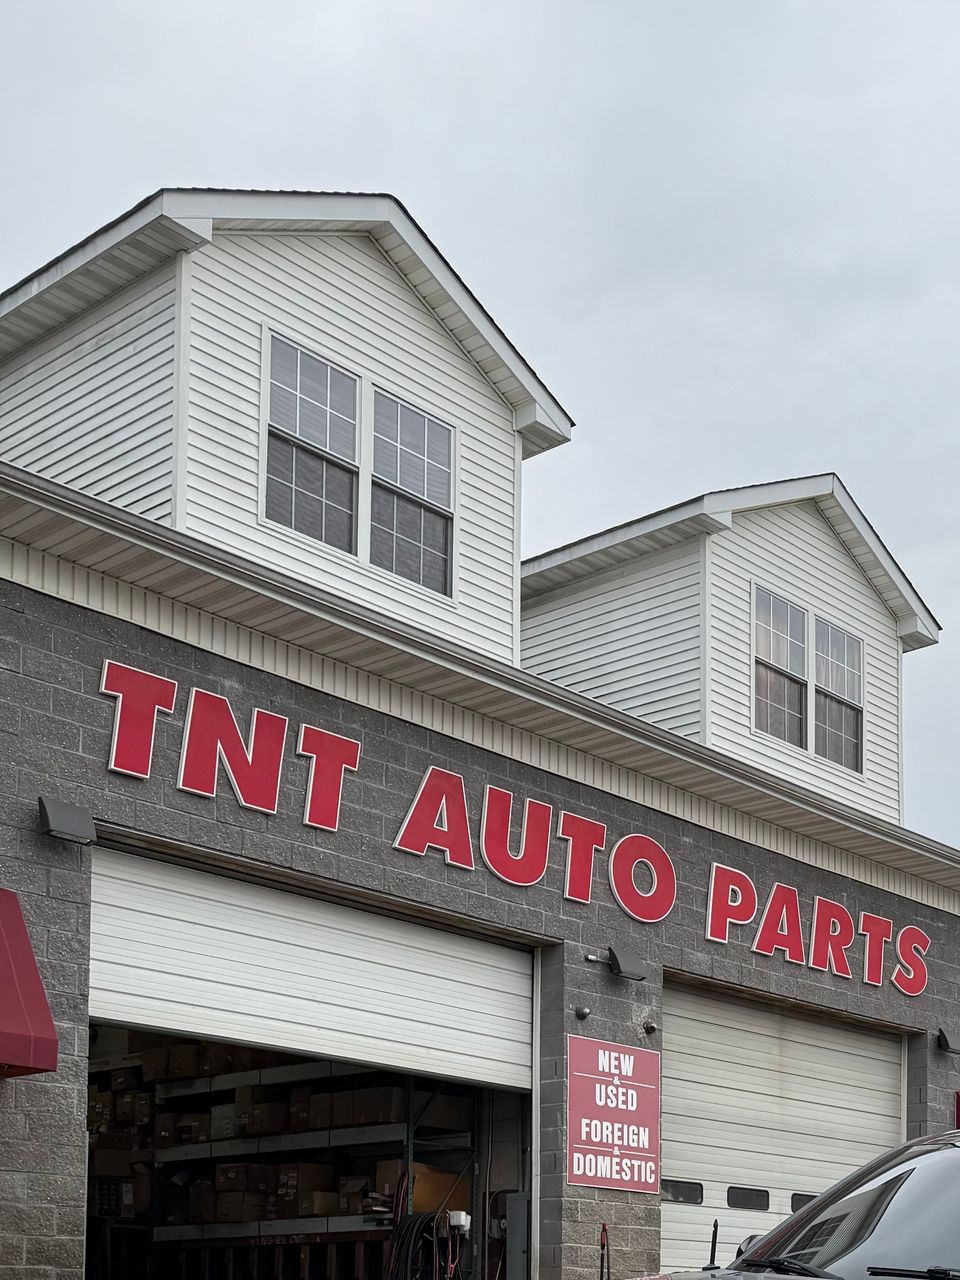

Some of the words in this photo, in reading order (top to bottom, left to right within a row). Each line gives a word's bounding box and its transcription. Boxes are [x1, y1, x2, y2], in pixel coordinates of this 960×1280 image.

[99, 658, 362, 832] TNT
[393, 765, 677, 923] AUTO
[705, 861, 932, 997] PARTS
[598, 1049, 634, 1077] NEW
[612, 1076, 621, 1086] &
[595, 1083, 637, 1112] USED
[581, 1118, 649, 1149] FOREIGN
[612, 1146, 621, 1156] &
[573, 1152, 656, 1184] DOMESTIC
